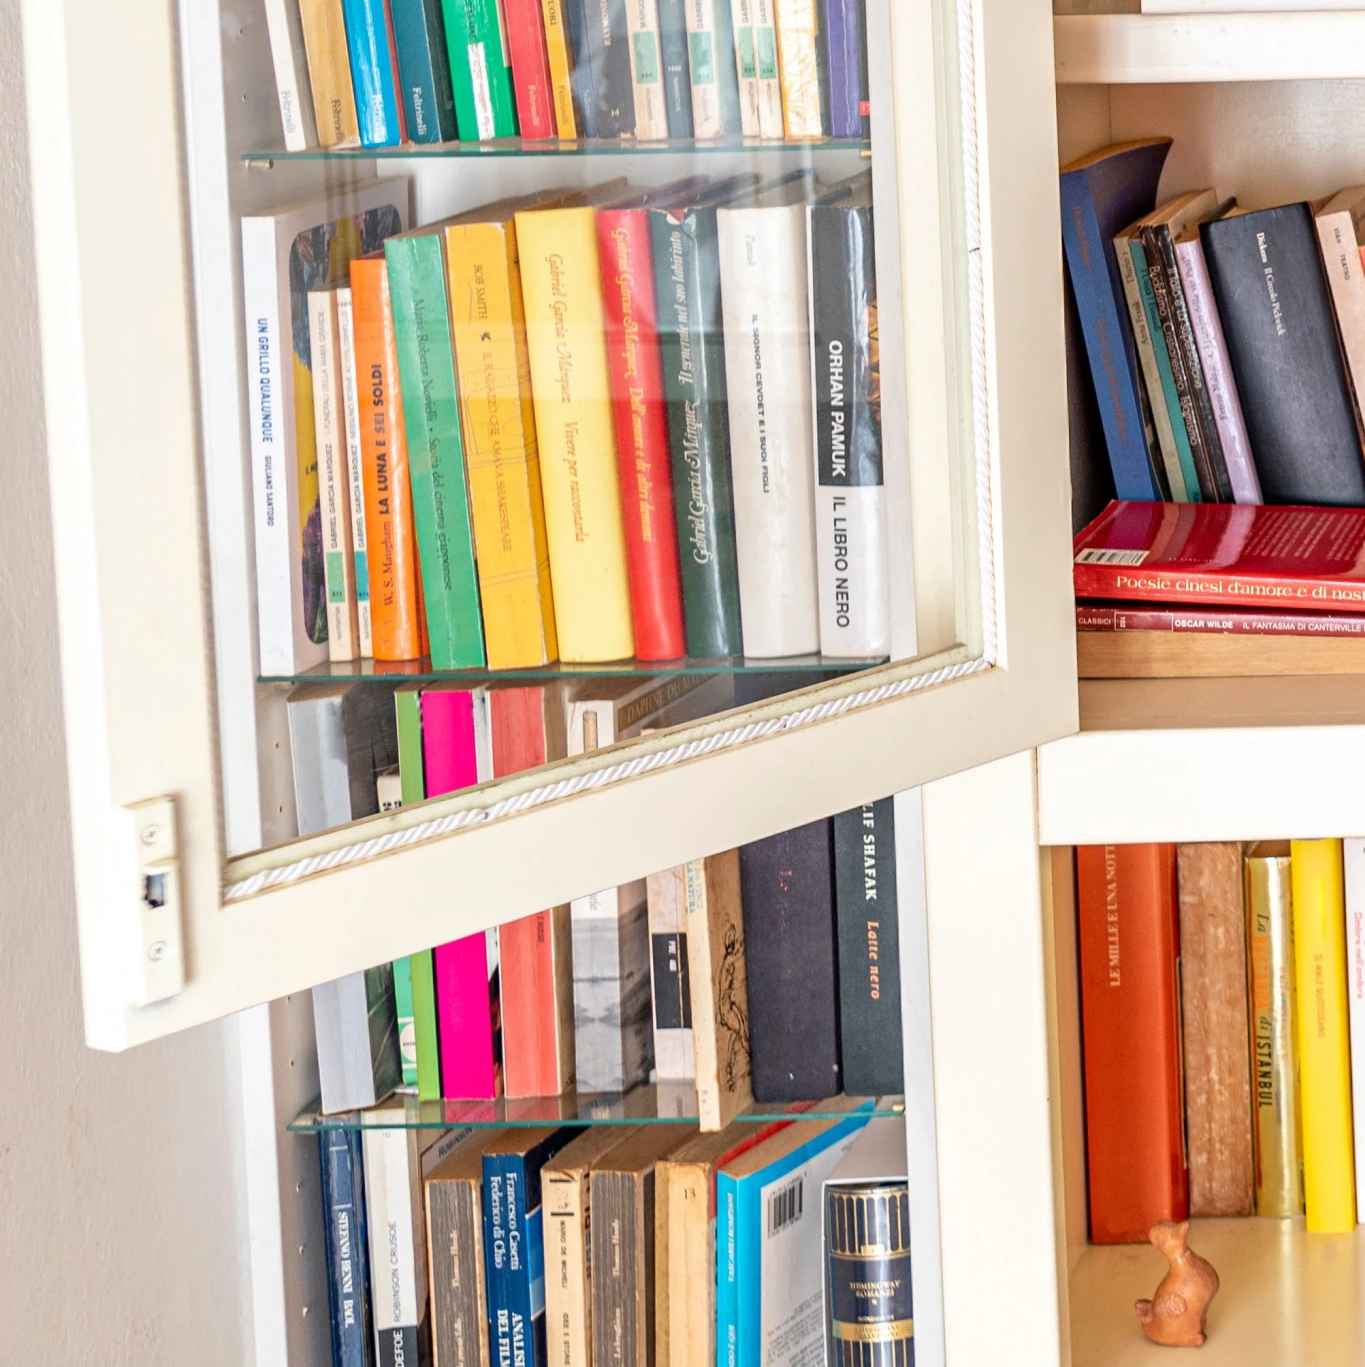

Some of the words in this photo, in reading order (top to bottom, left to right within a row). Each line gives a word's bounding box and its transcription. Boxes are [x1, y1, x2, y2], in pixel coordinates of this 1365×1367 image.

[371, 363, 385, 405] SOLDI
[828, 340, 843, 396] ORHAN
[374, 407, 387, 434] SEI
[375, 437, 387, 448] E
[831, 408, 847, 478] PAMUK
[376, 452, 390, 494] LUNA
[379, 496, 391, 515] LA
[833, 496, 846, 510] IL
[834, 518, 848, 571] LIBRO
[836, 577, 851, 629] NERO
[1117, 575, 1172, 591] Poesie
[1176, 577, 1224, 594] cinesi
[1228, 579, 1295, 598] d'amore
[1297, 587, 1308, 597] e
[1311, 584, 1328, 599] di
[1175, 619, 1204, 629] OSCAR
[1206, 620, 1235, 630] WILDE
[863, 832, 878, 902] SHAFAK
[866, 919, 878, 960] Latte
[869, 964, 881, 1000] nero
